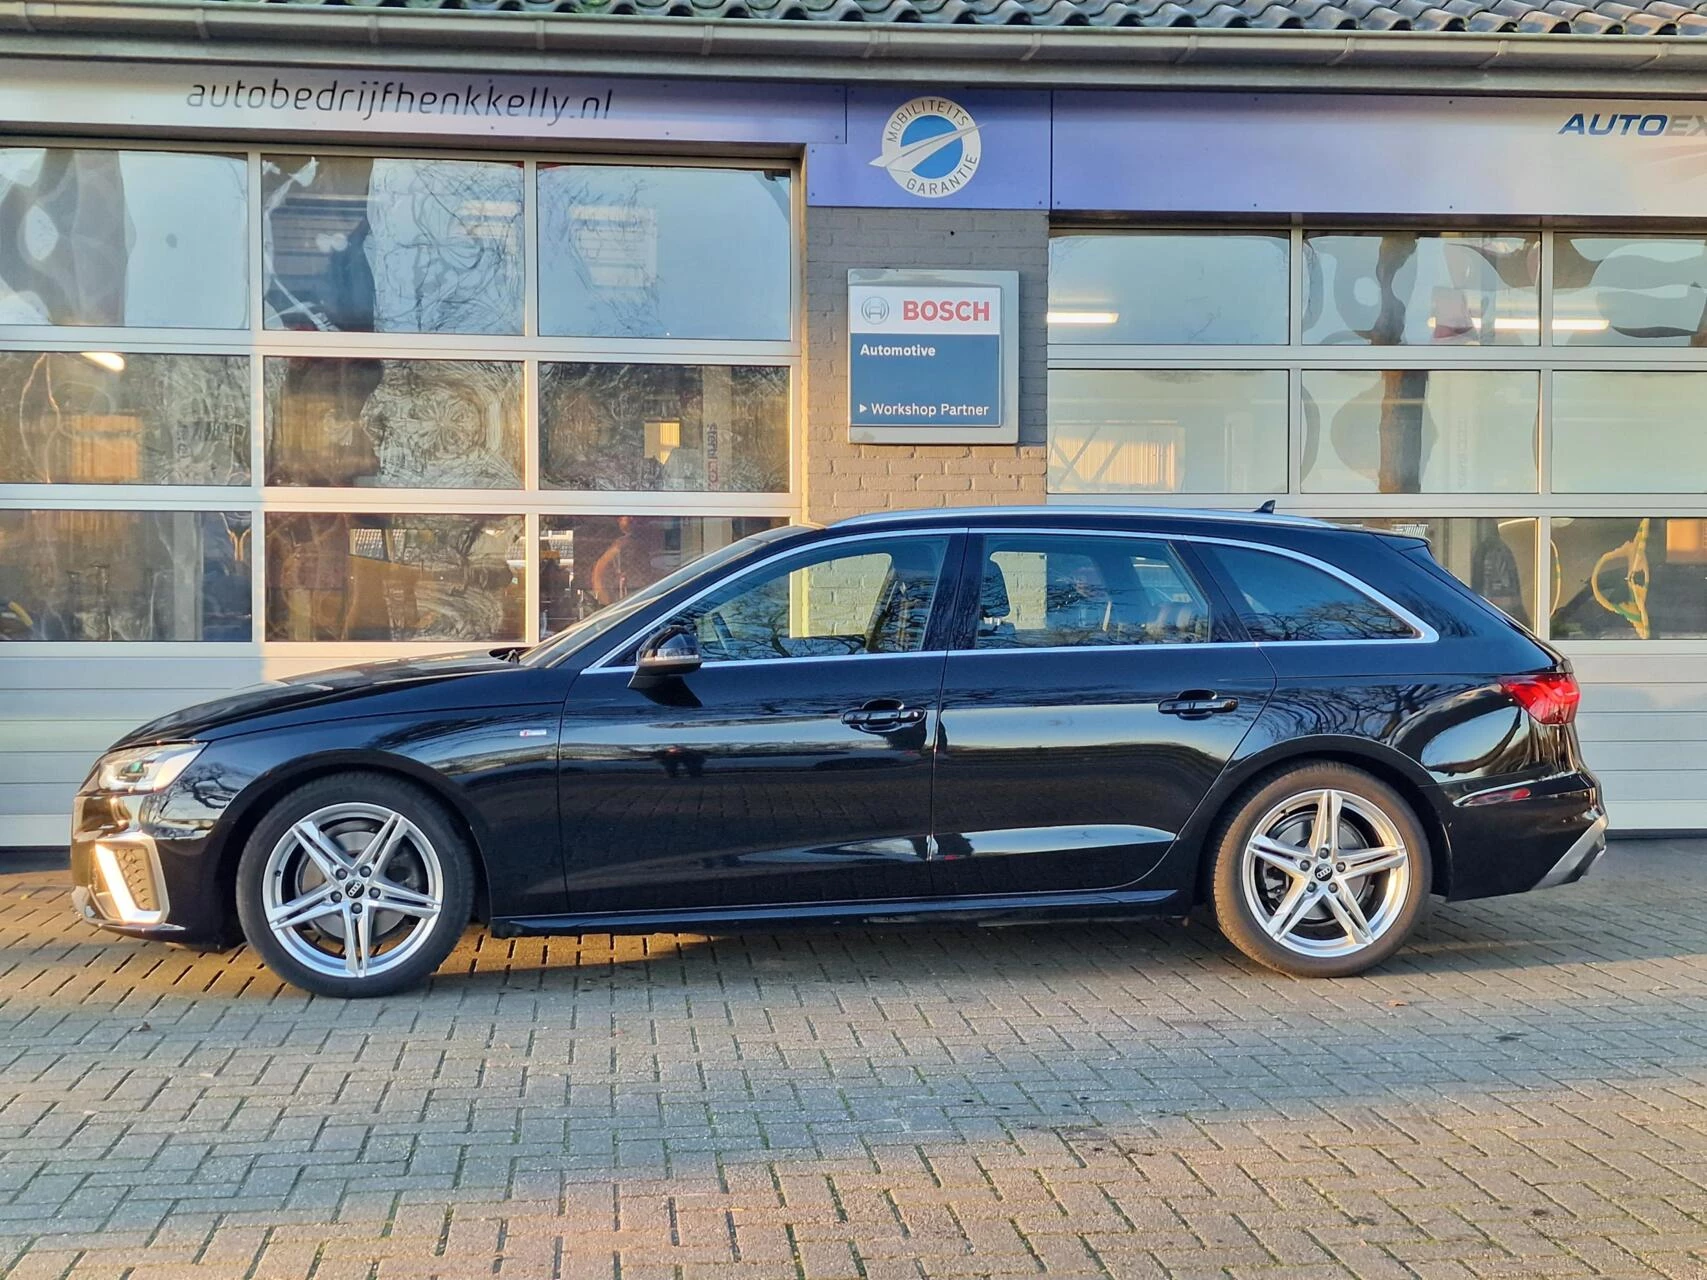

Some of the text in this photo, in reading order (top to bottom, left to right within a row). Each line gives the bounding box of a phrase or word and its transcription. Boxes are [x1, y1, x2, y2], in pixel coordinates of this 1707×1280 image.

[187, 78, 614, 126] autobedrijfhenkkelly.nl
[887, 99, 969, 142] MOBILITEITS
[906, 154, 978, 195] GARANTIE
[903, 300, 989, 321] BOSCH
[860, 344, 936, 356] Automotive
[871, 403, 989, 417] Workshop Partner
